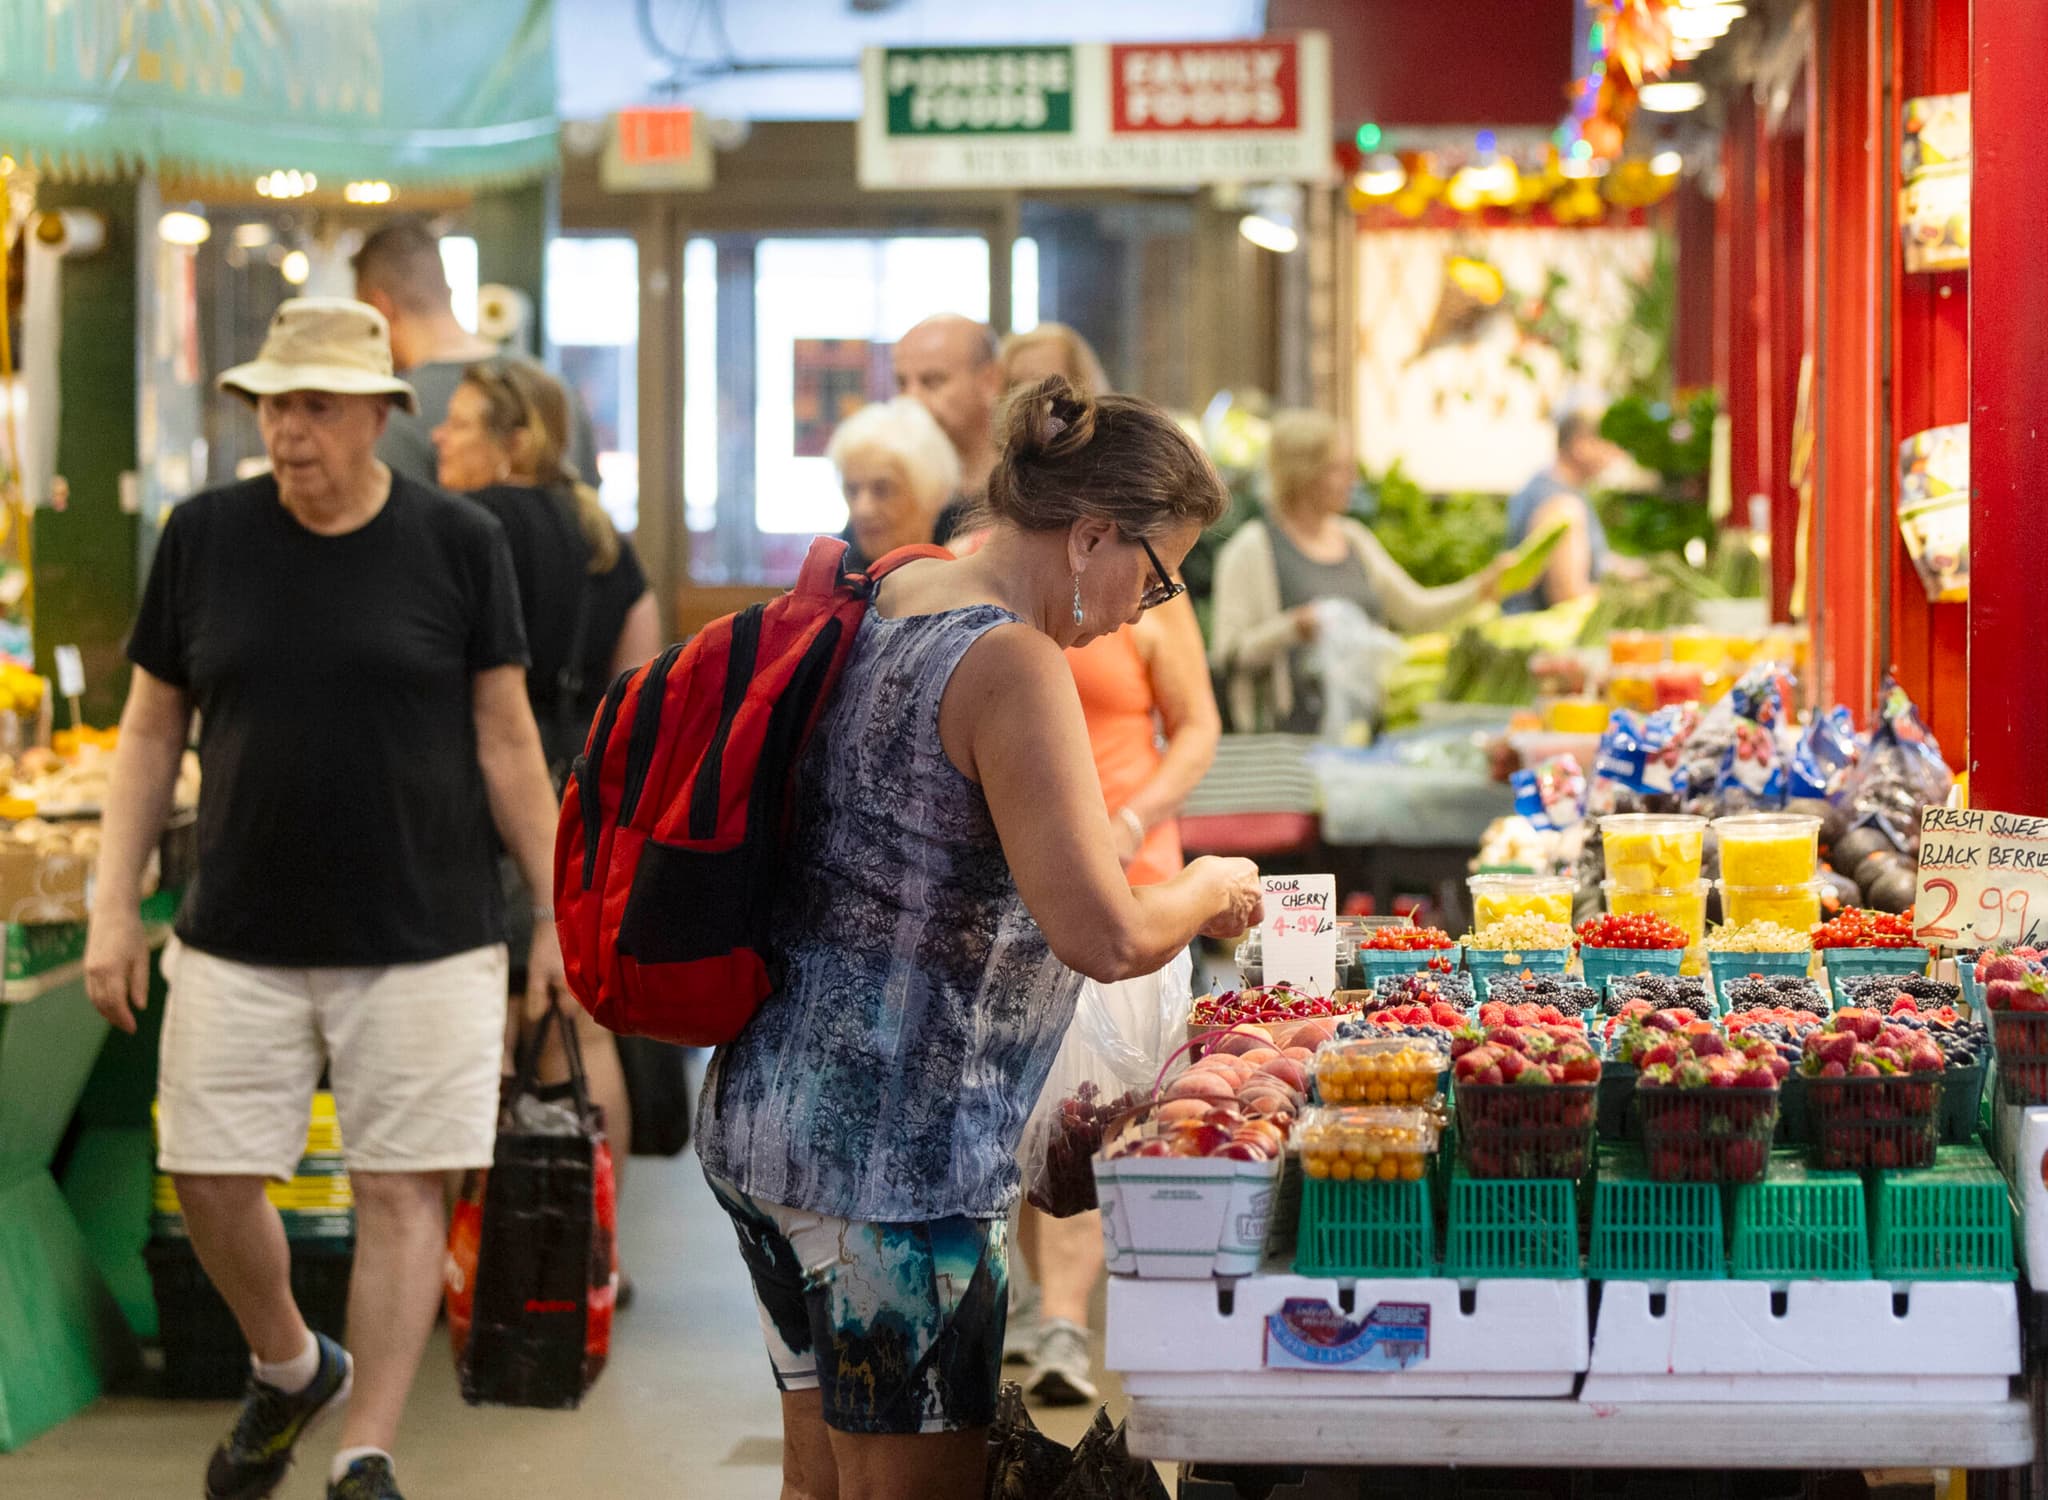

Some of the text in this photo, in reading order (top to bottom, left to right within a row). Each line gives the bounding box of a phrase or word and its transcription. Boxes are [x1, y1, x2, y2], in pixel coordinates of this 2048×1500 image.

[1123, 50, 1283, 84] FAMILY
[910, 88, 1047, 129] FOODS
[1126, 85, 1283, 125] FOODS
[1922, 809, 2048, 836] FRESH SWEE
[1921, 843, 1981, 866] BLACK
[1265, 880, 1300, 892] SOUR
[1282, 892, 1328, 910] CHERRY
